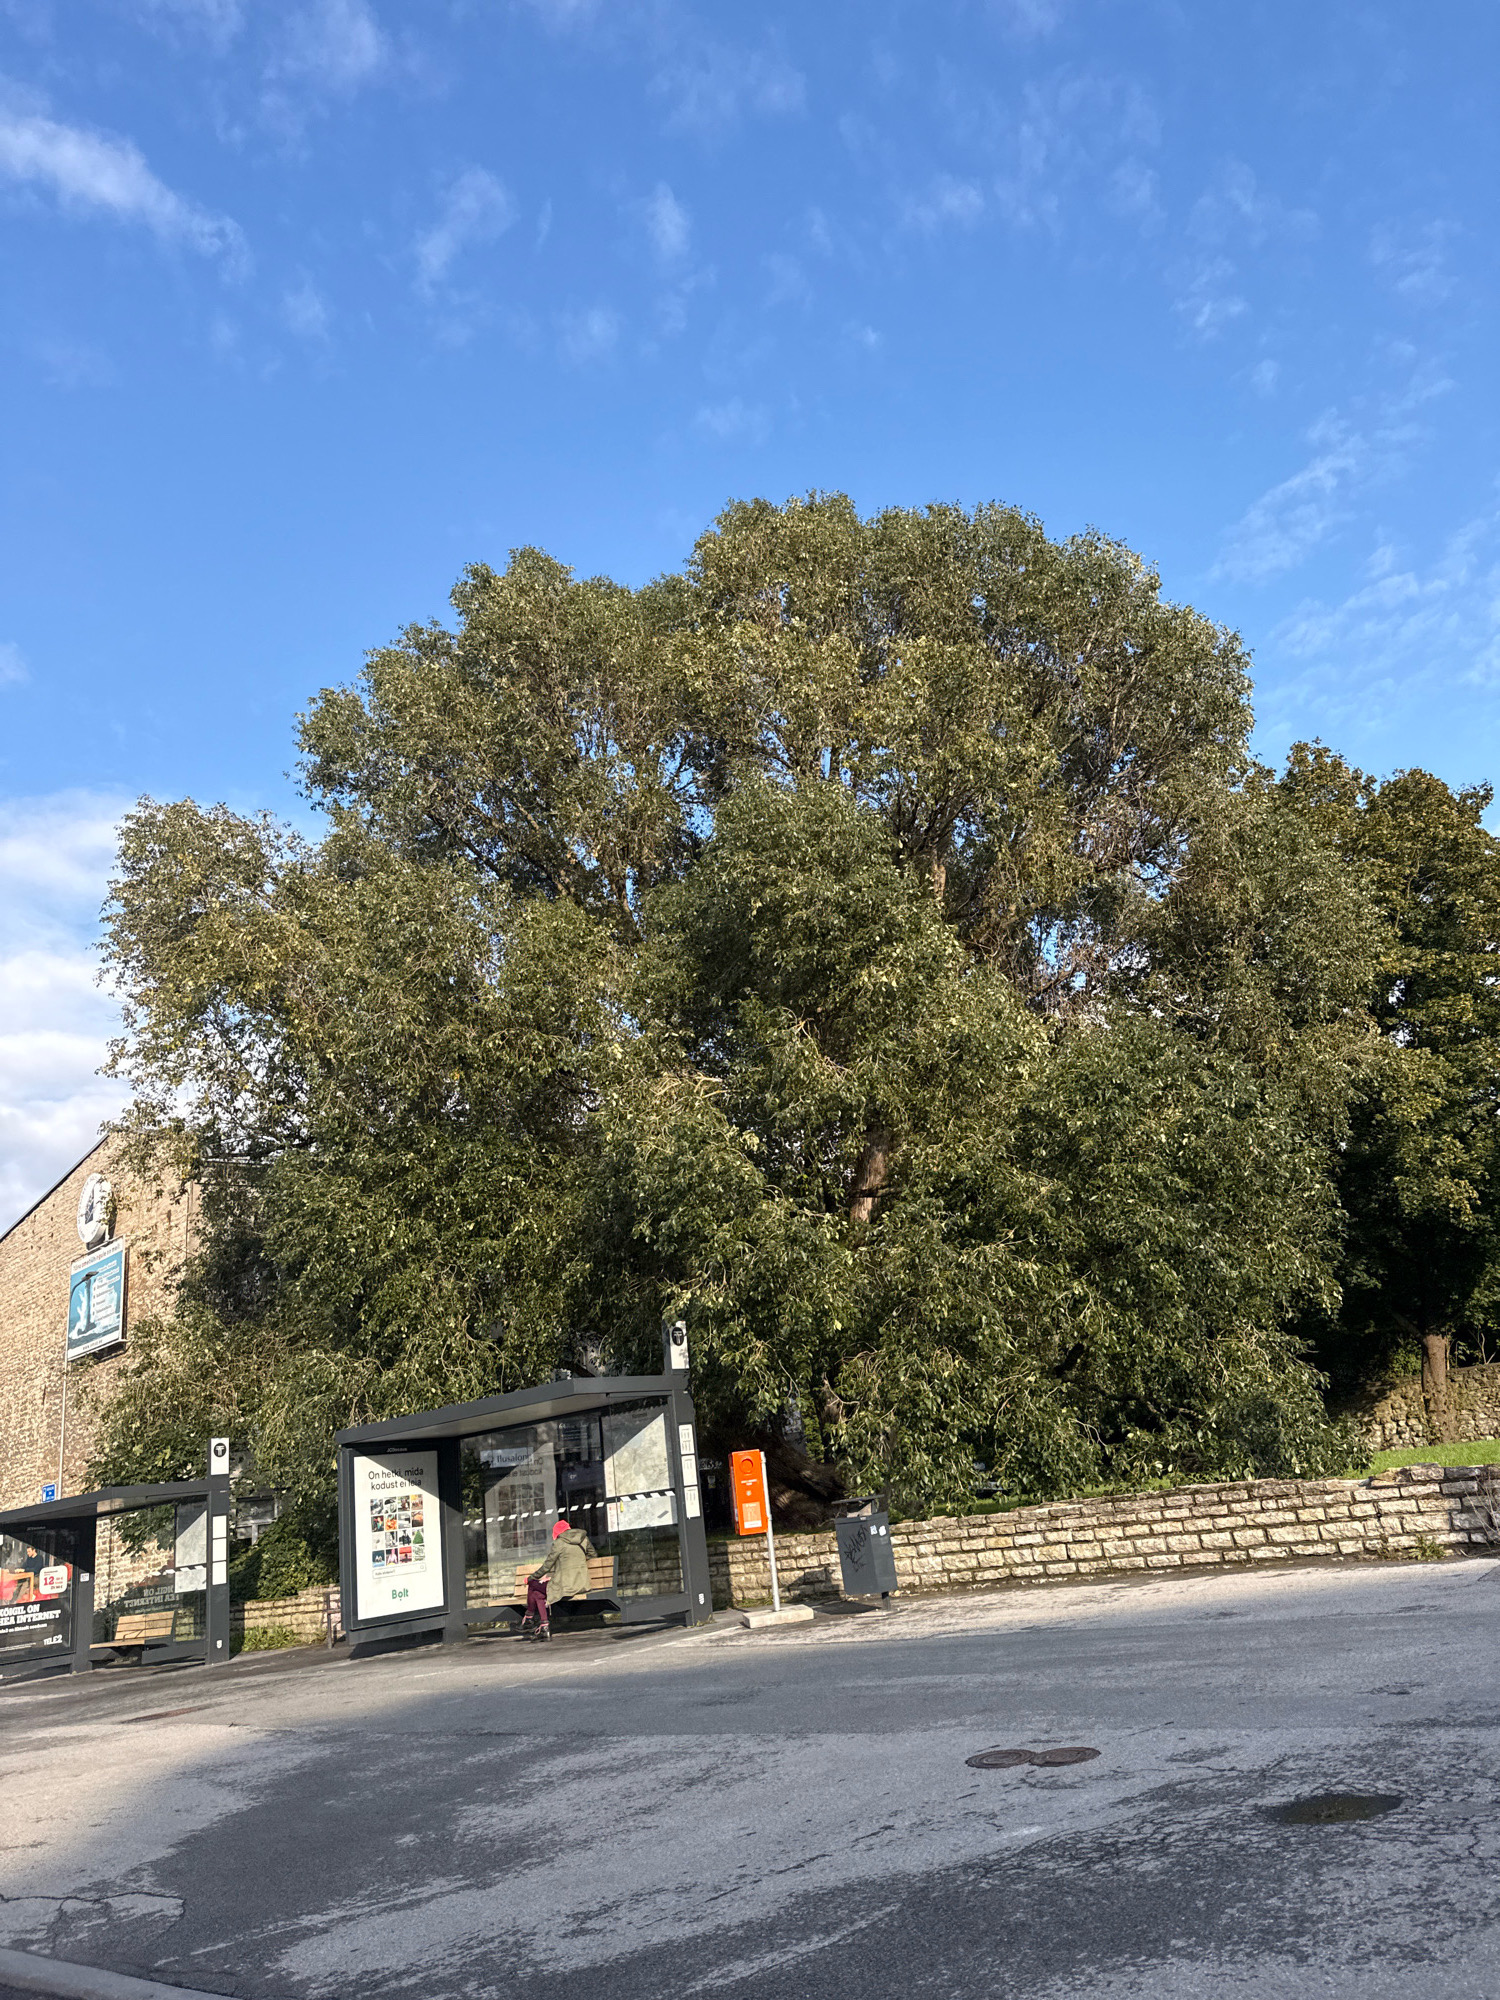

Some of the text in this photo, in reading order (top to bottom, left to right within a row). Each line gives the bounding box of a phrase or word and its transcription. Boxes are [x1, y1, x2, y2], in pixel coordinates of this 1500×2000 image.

[368, 1467, 424, 1480] On hetki, mida
[370, 1478, 422, 1490] kodust ei leia
[43, 1576, 55, 1586] 12
[391, 1588, 409, 1601] Bolt
[27, 1603, 40, 1614] ON
[16, 1609, 61, 1624] INTERNET
[43, 1634, 63, 1646] TELE2
